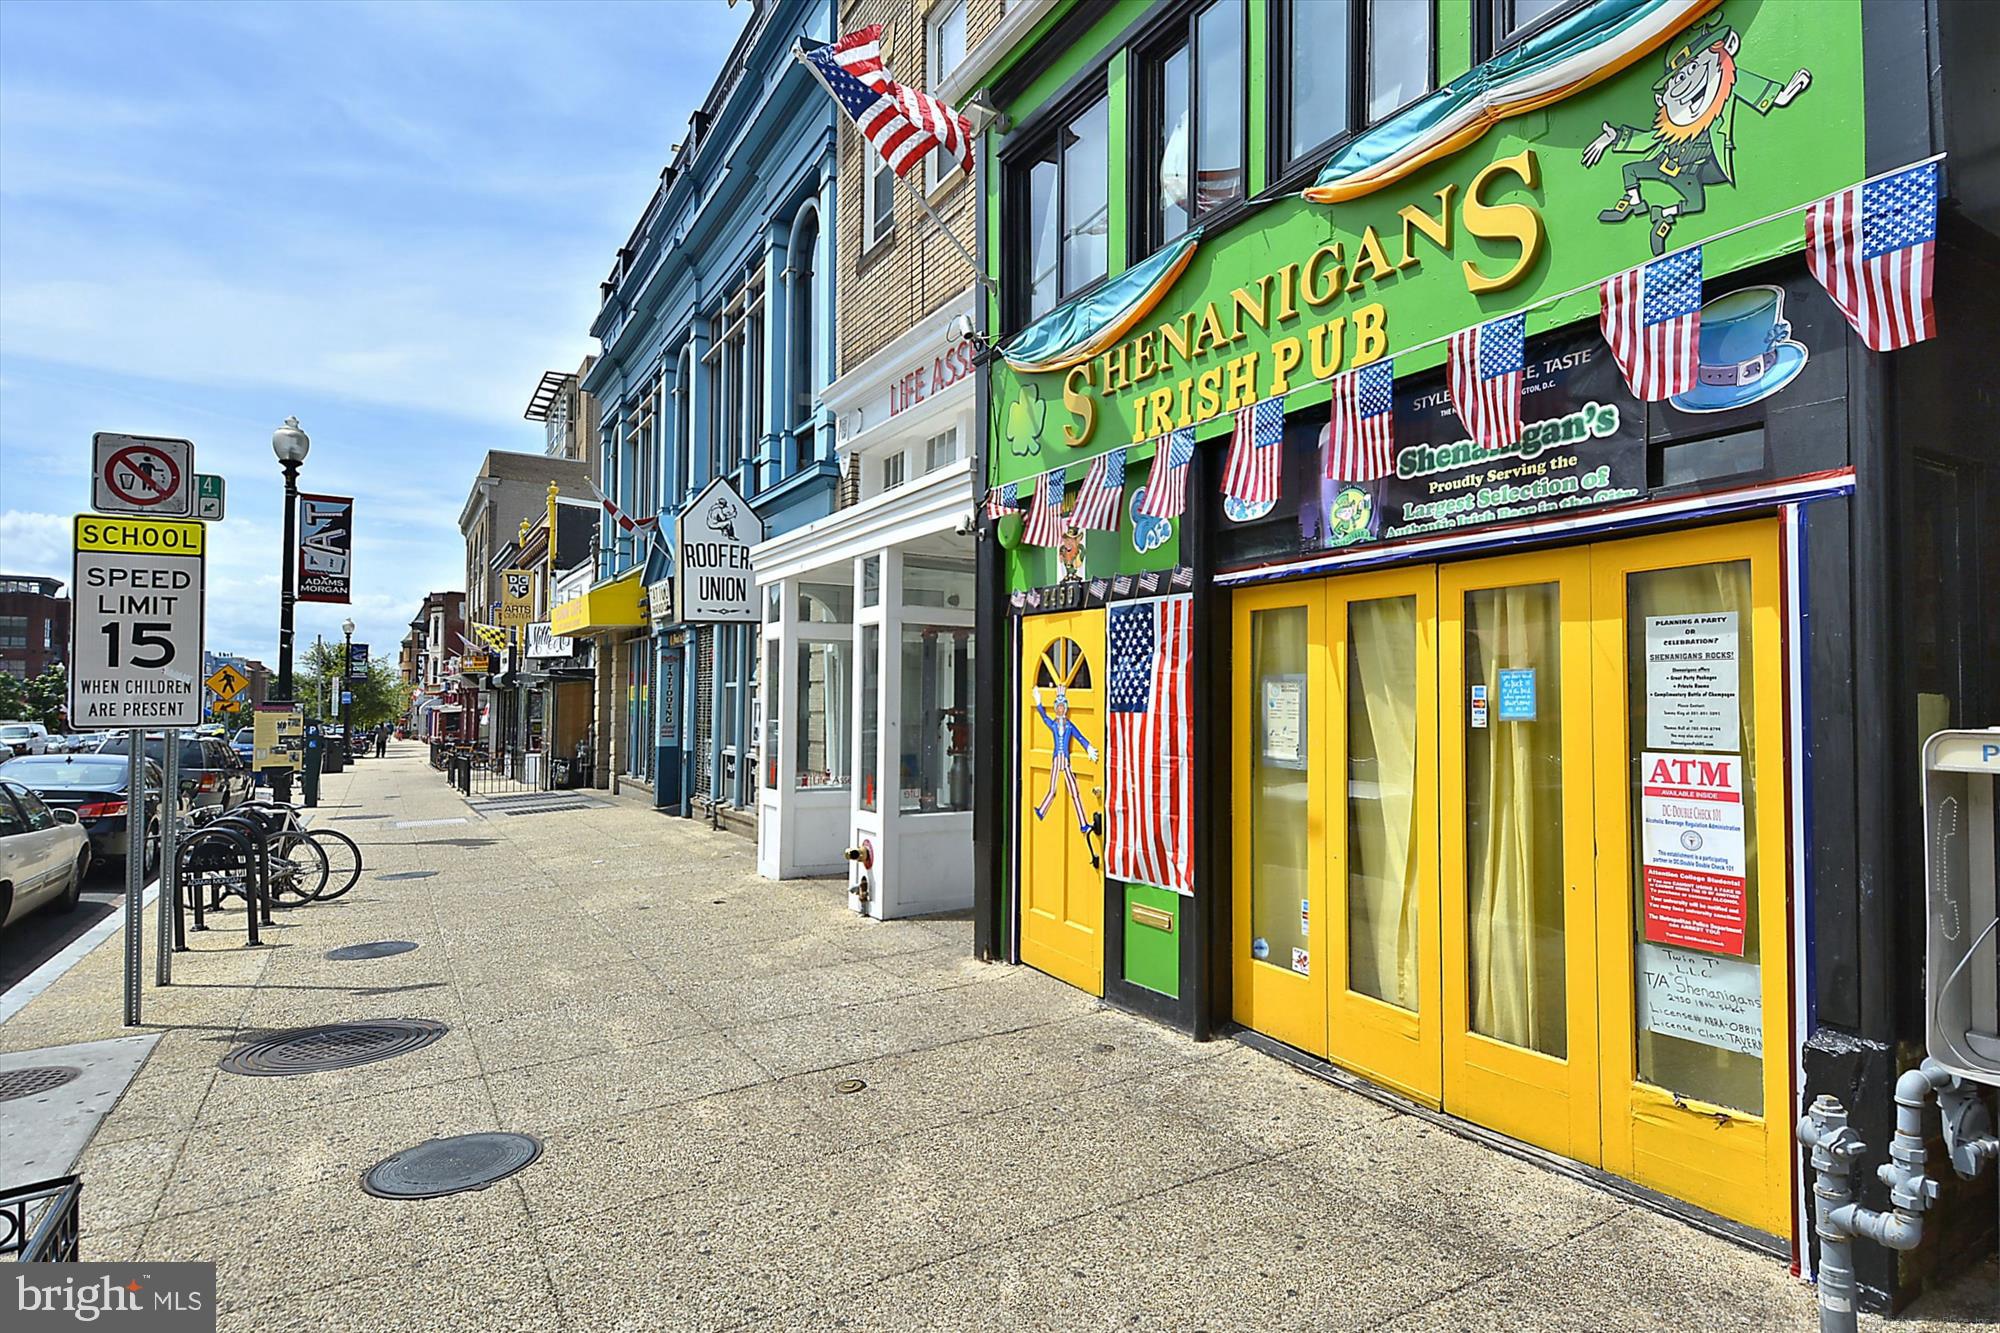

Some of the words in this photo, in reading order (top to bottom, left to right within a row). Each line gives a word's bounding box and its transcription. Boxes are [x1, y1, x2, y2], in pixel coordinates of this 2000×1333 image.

[1062, 150, 1545, 448] SHENANIGANS
[1543, 348, 1592, 374] TASTE
[1132, 353, 1258, 444] IRISH
[1271, 303, 1388, 405] PUB
[890, 366, 925, 416] LIFE
[1440, 408, 1451, 416] THE
[1429, 474, 1484, 494] Proudly
[1486, 463, 1547, 483] Serving
[1549, 454, 1578, 472] the
[203, 477, 212, 492] 4
[1402, 495, 1476, 522] Largest
[1476, 475, 1579, 508] Selection
[1580, 465, 1611, 489] of
[83, 525, 197, 548] SCHOOL
[303, 503, 349, 577] EAT
[685, 542, 753, 570] ROOFER
[87, 567, 191, 589] SPEED
[305, 577, 344, 587] ADAMS
[301, 585, 348, 594] MORGAN
[699, 576, 746, 601] UNION
[1043, 585, 1074, 608] 2450
[99, 595, 178, 615] LIMIT
[505, 605, 531, 613] ARTS
[1655, 618, 1692, 626] PLANNING
[1701, 616, 1727, 624] PARTY
[101, 621, 176, 669] 15
[1664, 637, 1719, 646] CELEBRATION?
[1649, 652, 1703, 661] SHENANIGANS
[1705, 651, 1734, 660] ROCKS!
[81, 680, 119, 694] WHEN
[125, 680, 192, 694] CHILDREN
[666, 664, 674, 723] TATTOOING
[88, 702, 117, 717] ARE
[123, 702, 185, 717] PRESENT
[1648, 758, 1731, 787] ATM
[1661, 789, 1695, 797] AVAILABLE
[1696, 791, 1718, 799] INSIDE
[1646, 817, 1664, 825] Alcoholic
[1665, 819, 1684, 828] Beverage
[1685, 820, 1708, 829] Regulation
[1709, 822, 1740, 832] Administration
[1667, 851, 1694, 859] establishment
[1702, 855, 1728, 864] participating
[1648, 869, 1678, 878] Attention
[1680, 872, 1705, 882] College
[1712, 863, 1725, 871] Check
[1692, 920, 1709, 928] Police
[1710, 923, 1743, 934] Department
[1662, 949, 1695, 964] Twin
[1643, 971, 1670, 989] T/A
[1652, 1016, 1693, 1033] License
